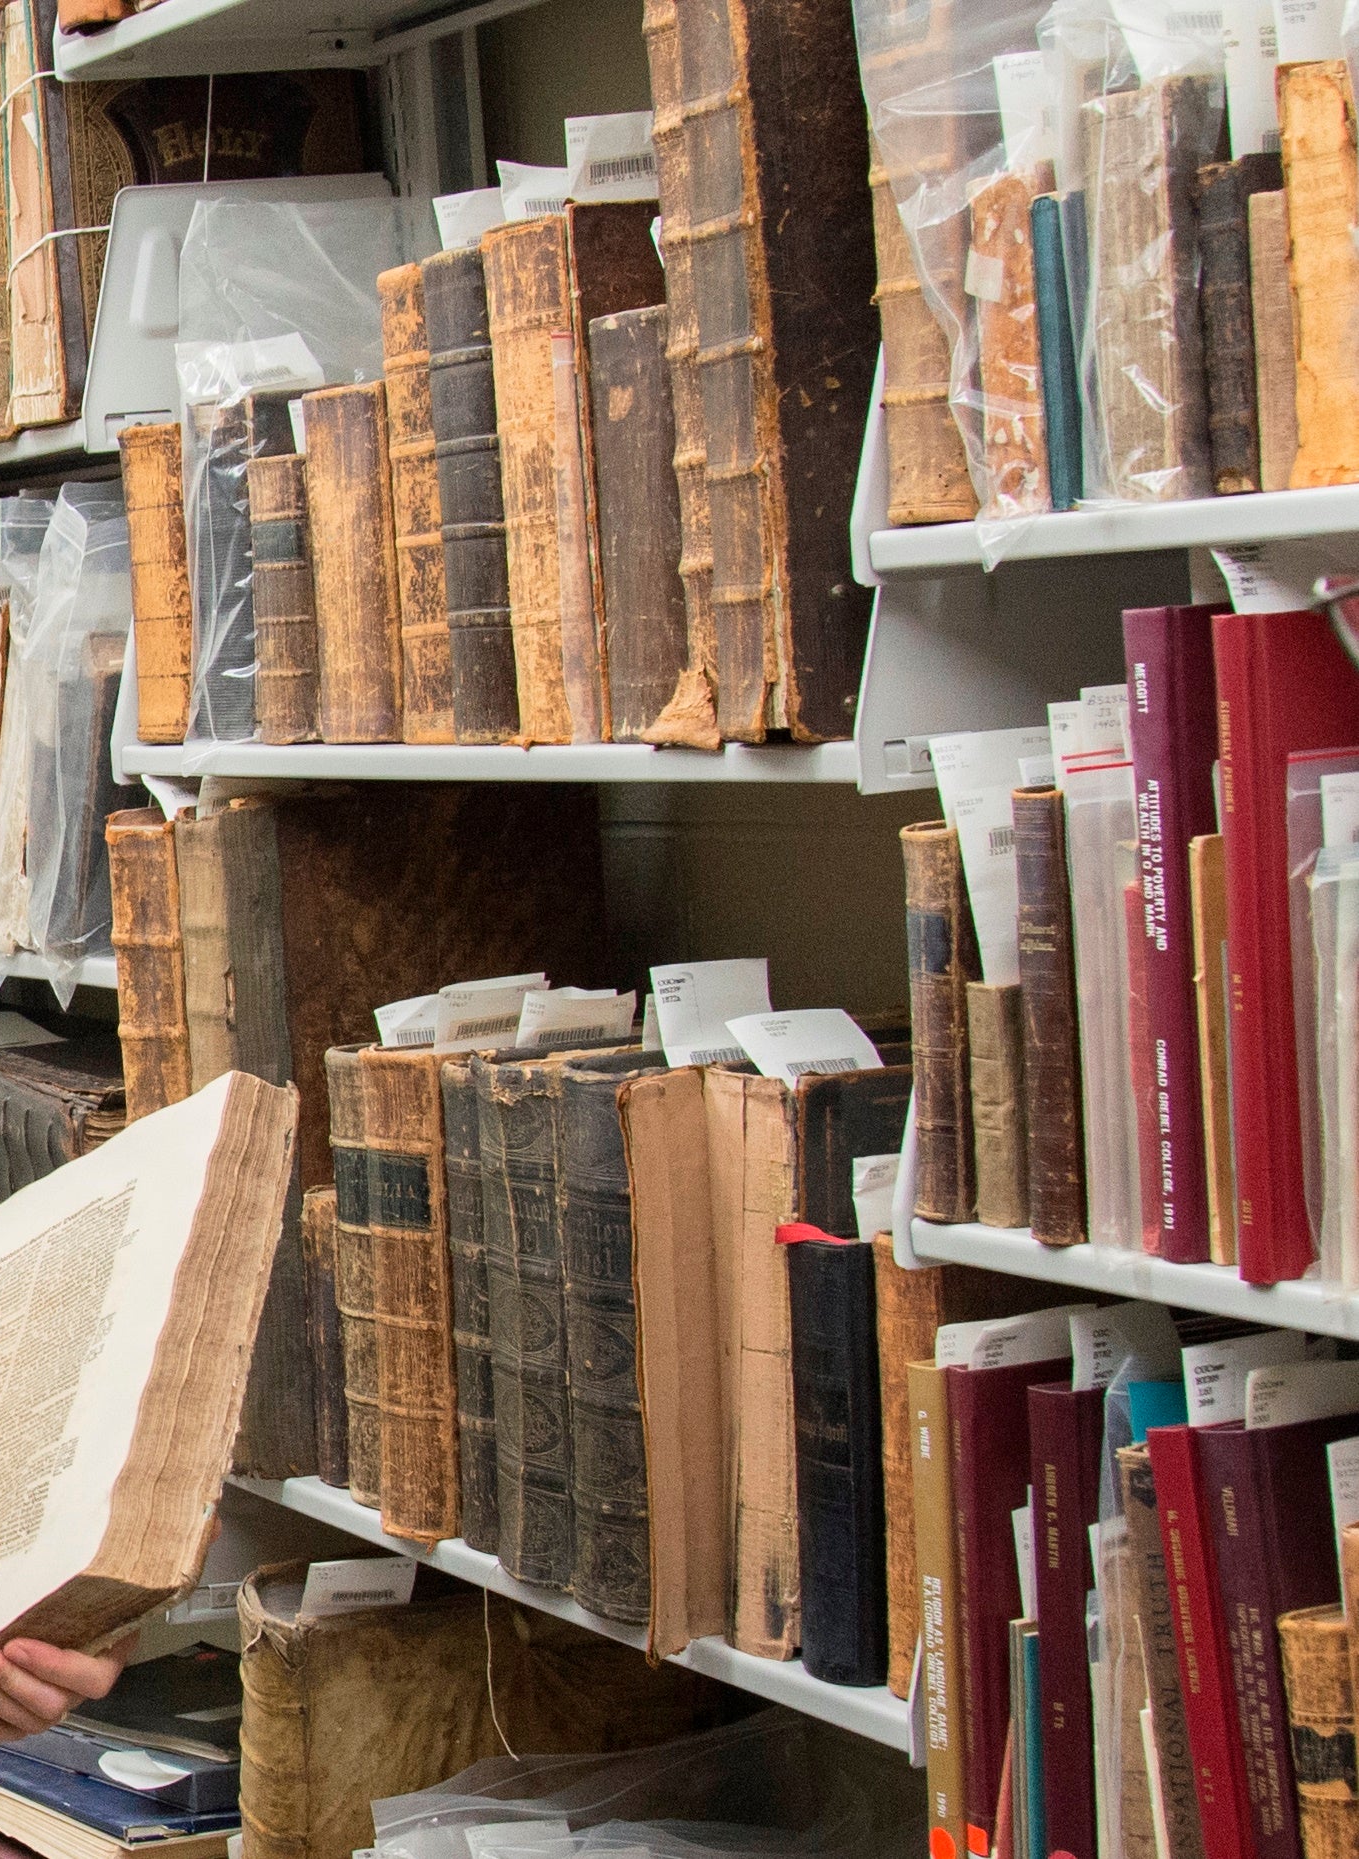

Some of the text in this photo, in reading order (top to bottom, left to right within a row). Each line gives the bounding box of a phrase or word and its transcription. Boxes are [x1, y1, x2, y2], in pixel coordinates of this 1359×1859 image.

[1134, 663, 1148, 713] MEGGITT
[1220, 701, 1232, 760] KIMBERLY
[1138, 792, 1152, 840] WEALTH
[1141, 844, 1152, 856] IN
[1147, 780, 1168, 951] ATTITUDES TO POVERTY AND
[1142, 875, 1154, 898] AND
[1144, 904, 1156, 938] MARK
[1156, 1039, 1167, 1086] CONRAD
[1159, 1092, 1170, 1134] GREBEL
[919, 1426, 931, 1459] WIEBE
[1045, 1463, 1058, 1507] ANDREW
[932, 1577, 943, 1627] RELIGION
[934, 1629, 943, 1645] AS
[936, 1791, 947, 1817] 1990
